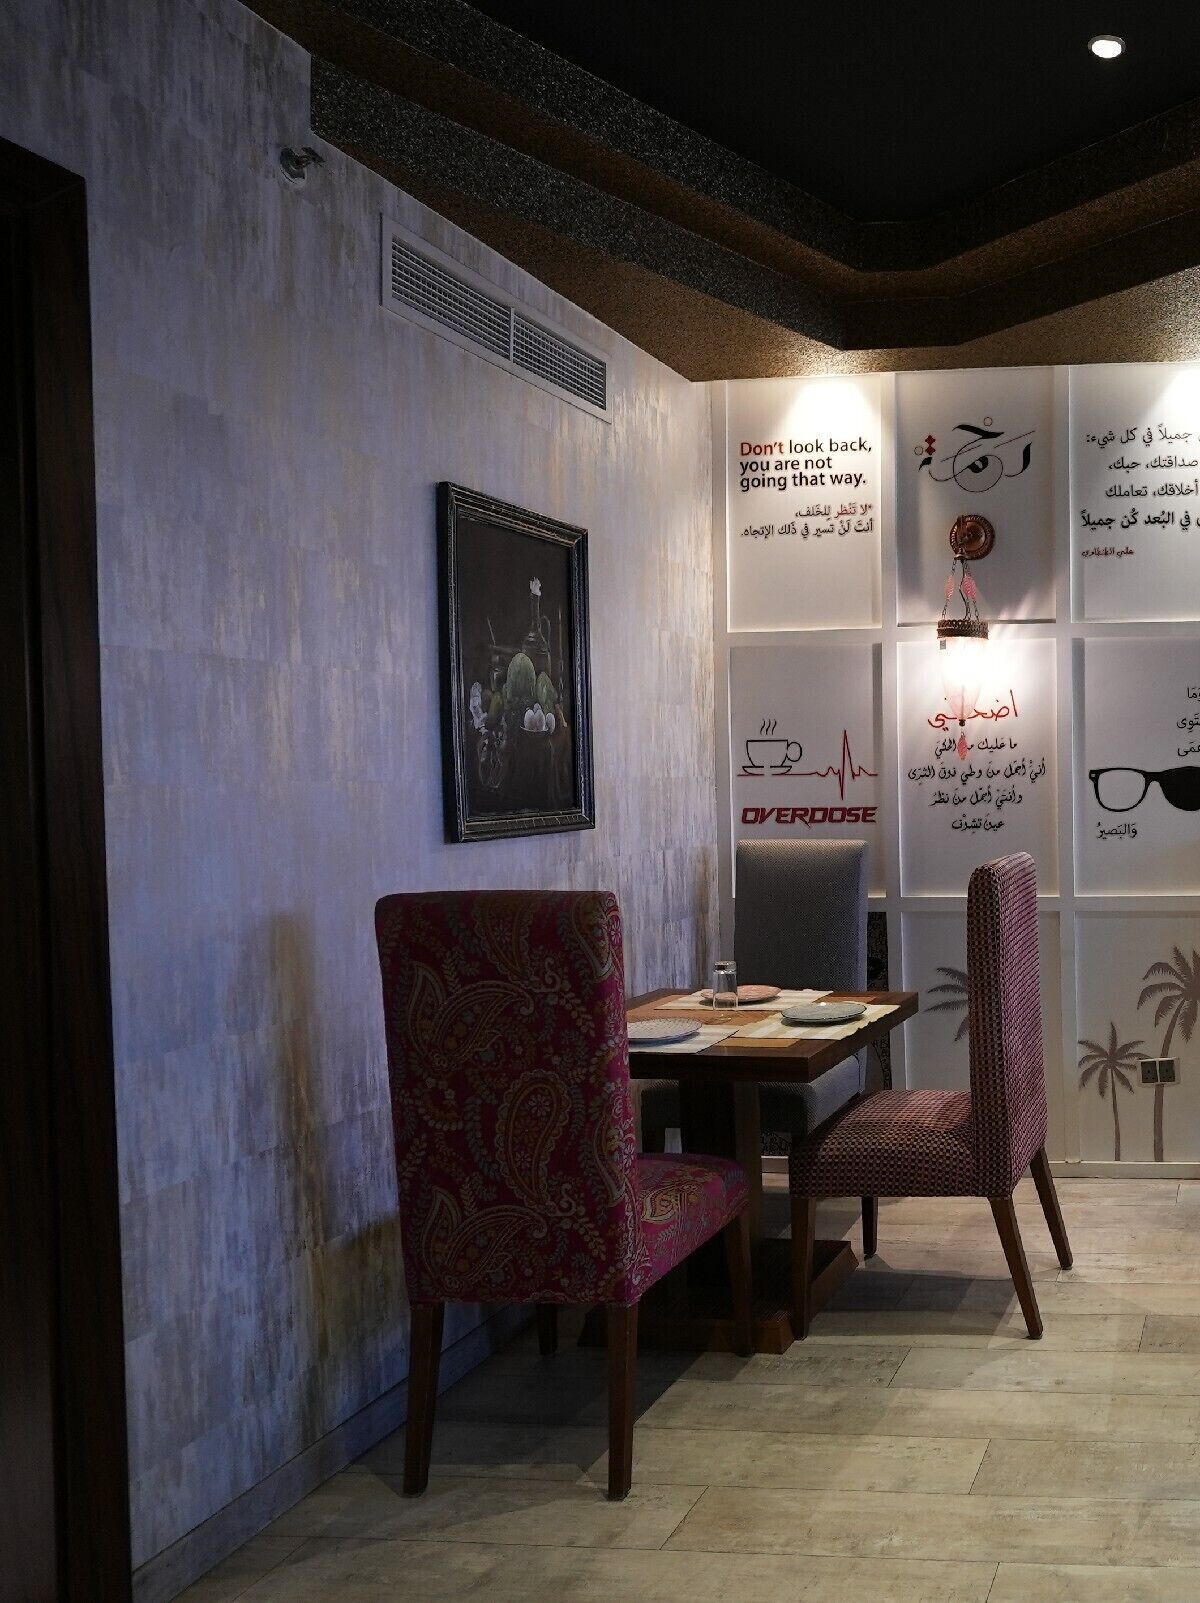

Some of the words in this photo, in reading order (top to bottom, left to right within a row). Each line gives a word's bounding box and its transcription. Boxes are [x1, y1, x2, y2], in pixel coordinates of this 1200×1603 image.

[1120, 428, 1137, 443] كل
[1143, 427, 1153, 446] في
[740, 442, 784, 456] Don't
[789, 439, 824, 454] look
[830, 437, 872, 453] back,
[740, 461, 769, 476] you
[774, 460, 799, 470] are
[805, 456, 832, 469] not
[740, 474, 787, 492] going
[792, 472, 825, 486] that
[830, 473, 866, 487] way.
[1106, 484, 1148, 498] تعاملك
[1180, 510, 1191, 531] في
[741, 807, 879, 829] OVERDOSE
